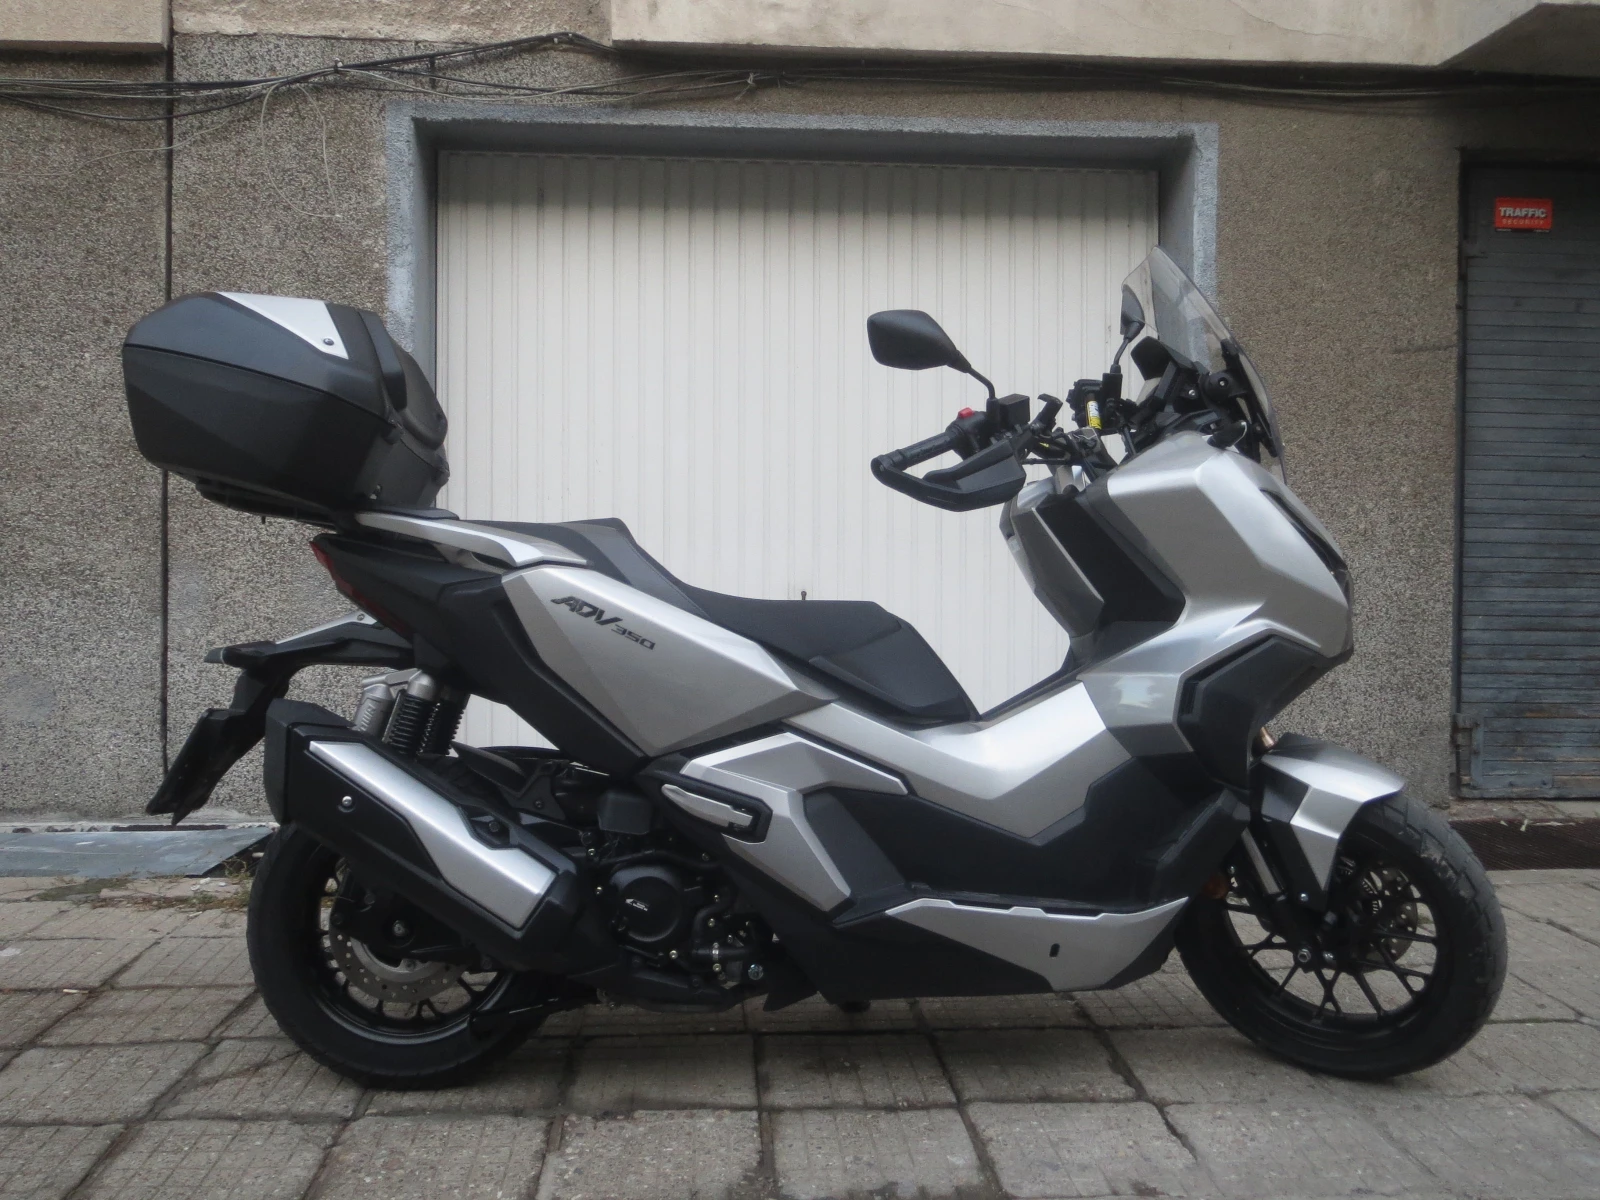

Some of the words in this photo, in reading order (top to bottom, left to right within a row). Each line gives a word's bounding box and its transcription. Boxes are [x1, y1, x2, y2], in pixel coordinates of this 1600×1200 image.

[1499, 206, 1547, 218] TRAFFIC
[550, 595, 623, 626] ADV
[611, 623, 656, 650] 350
